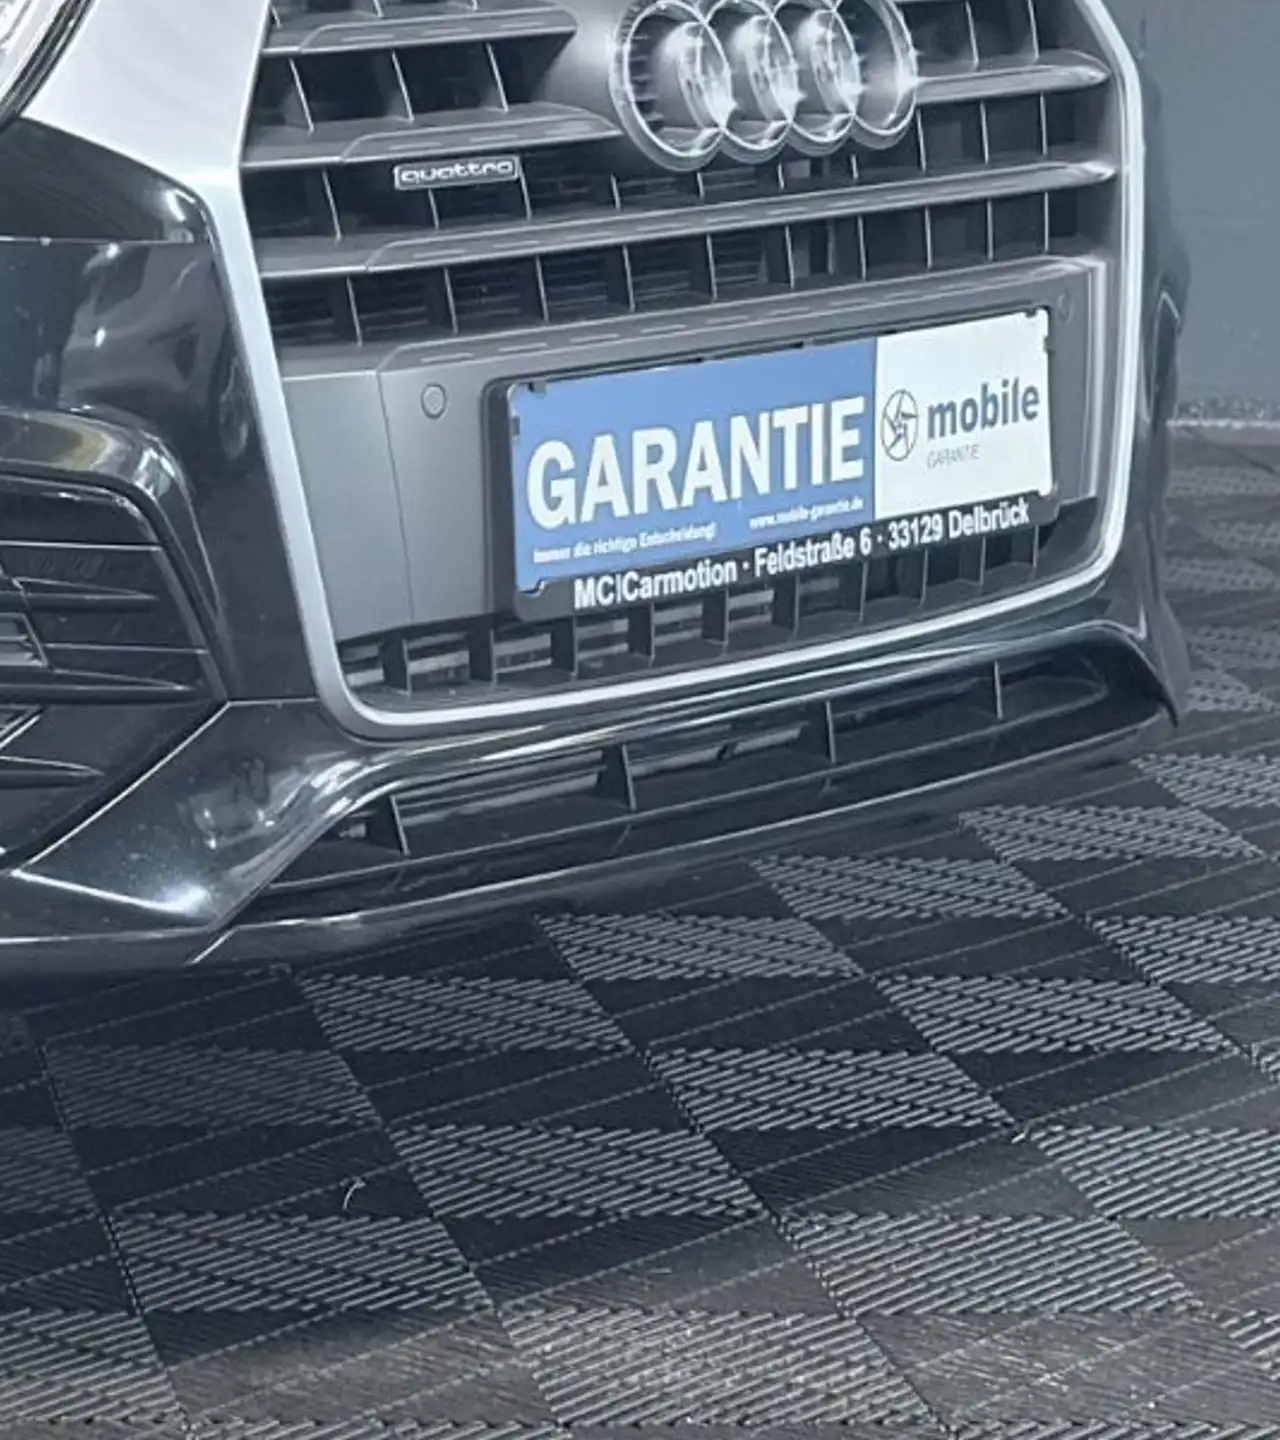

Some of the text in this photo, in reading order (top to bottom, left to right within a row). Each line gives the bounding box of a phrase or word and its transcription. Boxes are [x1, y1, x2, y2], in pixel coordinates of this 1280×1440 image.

[400, 160, 513, 185] quattro
[927, 376, 1040, 440] mobile
[526, 396, 865, 530] GARANTIE
[753, 529, 856, 578] Feldstraße
[859, 526, 872, 557] 6
[888, 512, 944, 551] 33129
[947, 501, 1030, 540] Delbrück
